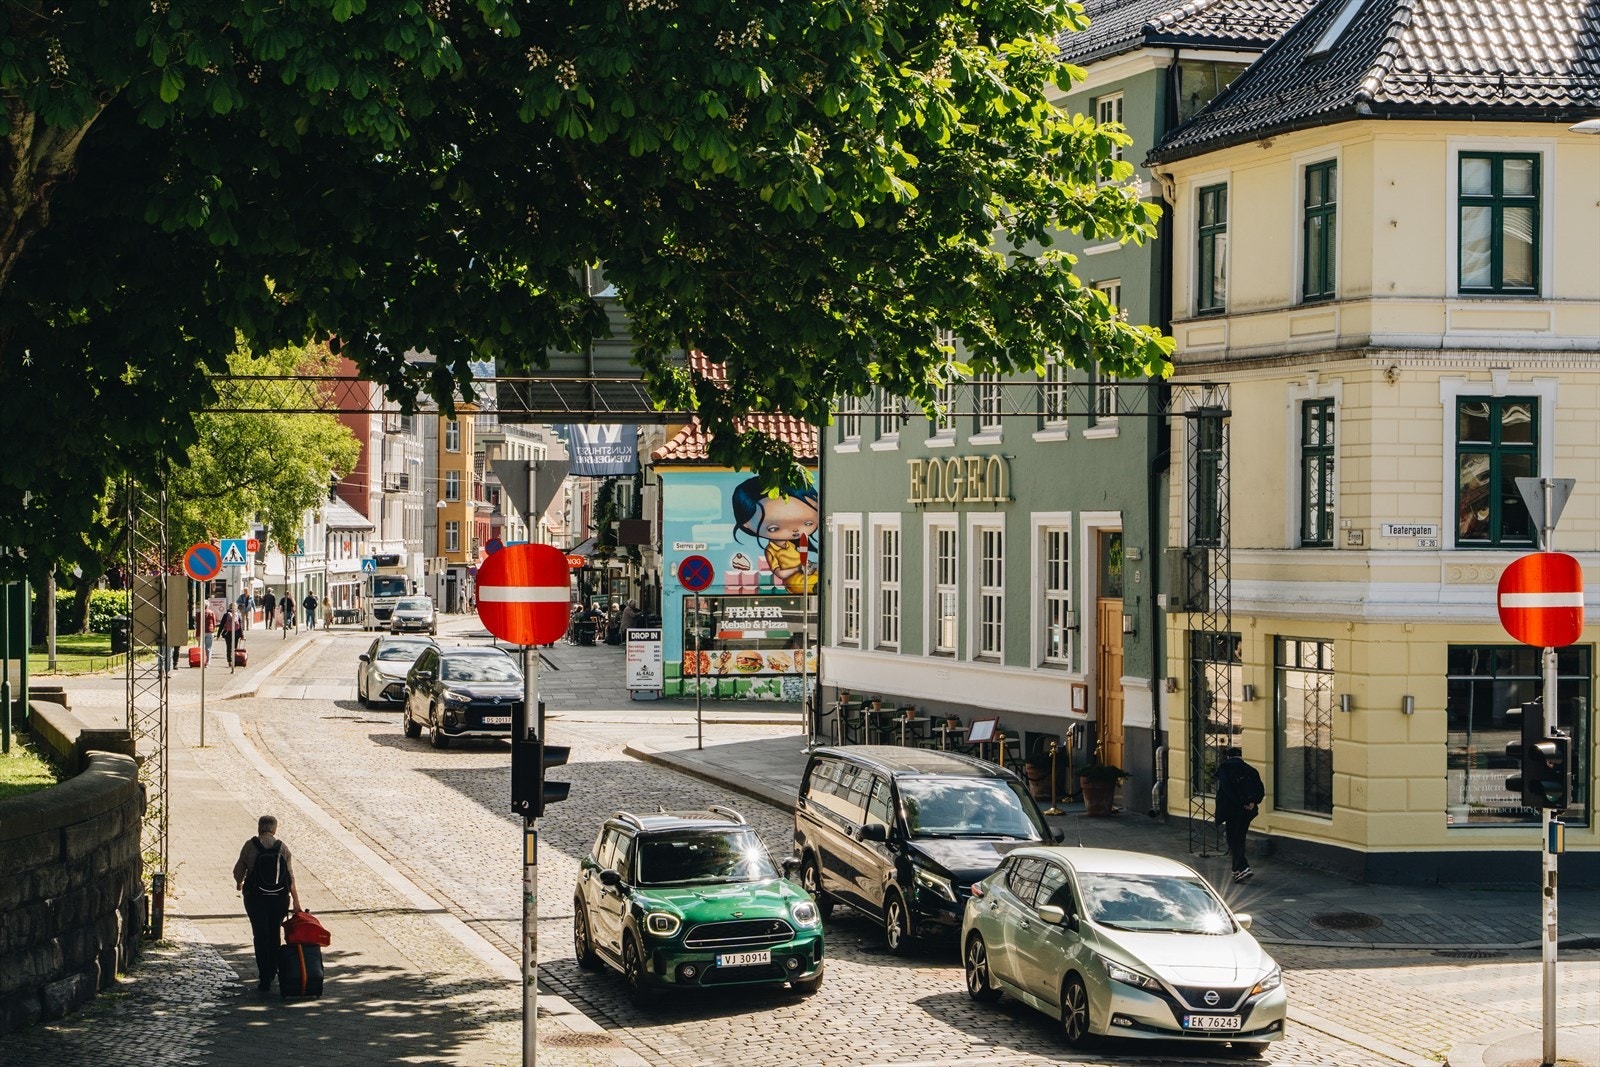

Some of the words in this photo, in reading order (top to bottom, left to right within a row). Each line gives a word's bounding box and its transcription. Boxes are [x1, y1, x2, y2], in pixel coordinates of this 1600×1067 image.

[906, 454, 1009, 503] ENGEN
[1388, 525, 1432, 536] Teatergaten
[726, 607, 783, 618] TEATER
[720, 620, 751, 629] Kebab
[753, 620, 761, 629] &
[762, 620, 788, 629] Pizza
[631, 632, 650, 640] DROP
[650, 632, 658, 640] IN
[725, 955, 736, 964] VJ
[740, 953, 768, 963] 30914
[1192, 1017, 1204, 1027] EK
[1208, 1017, 1238, 1028] 76243
